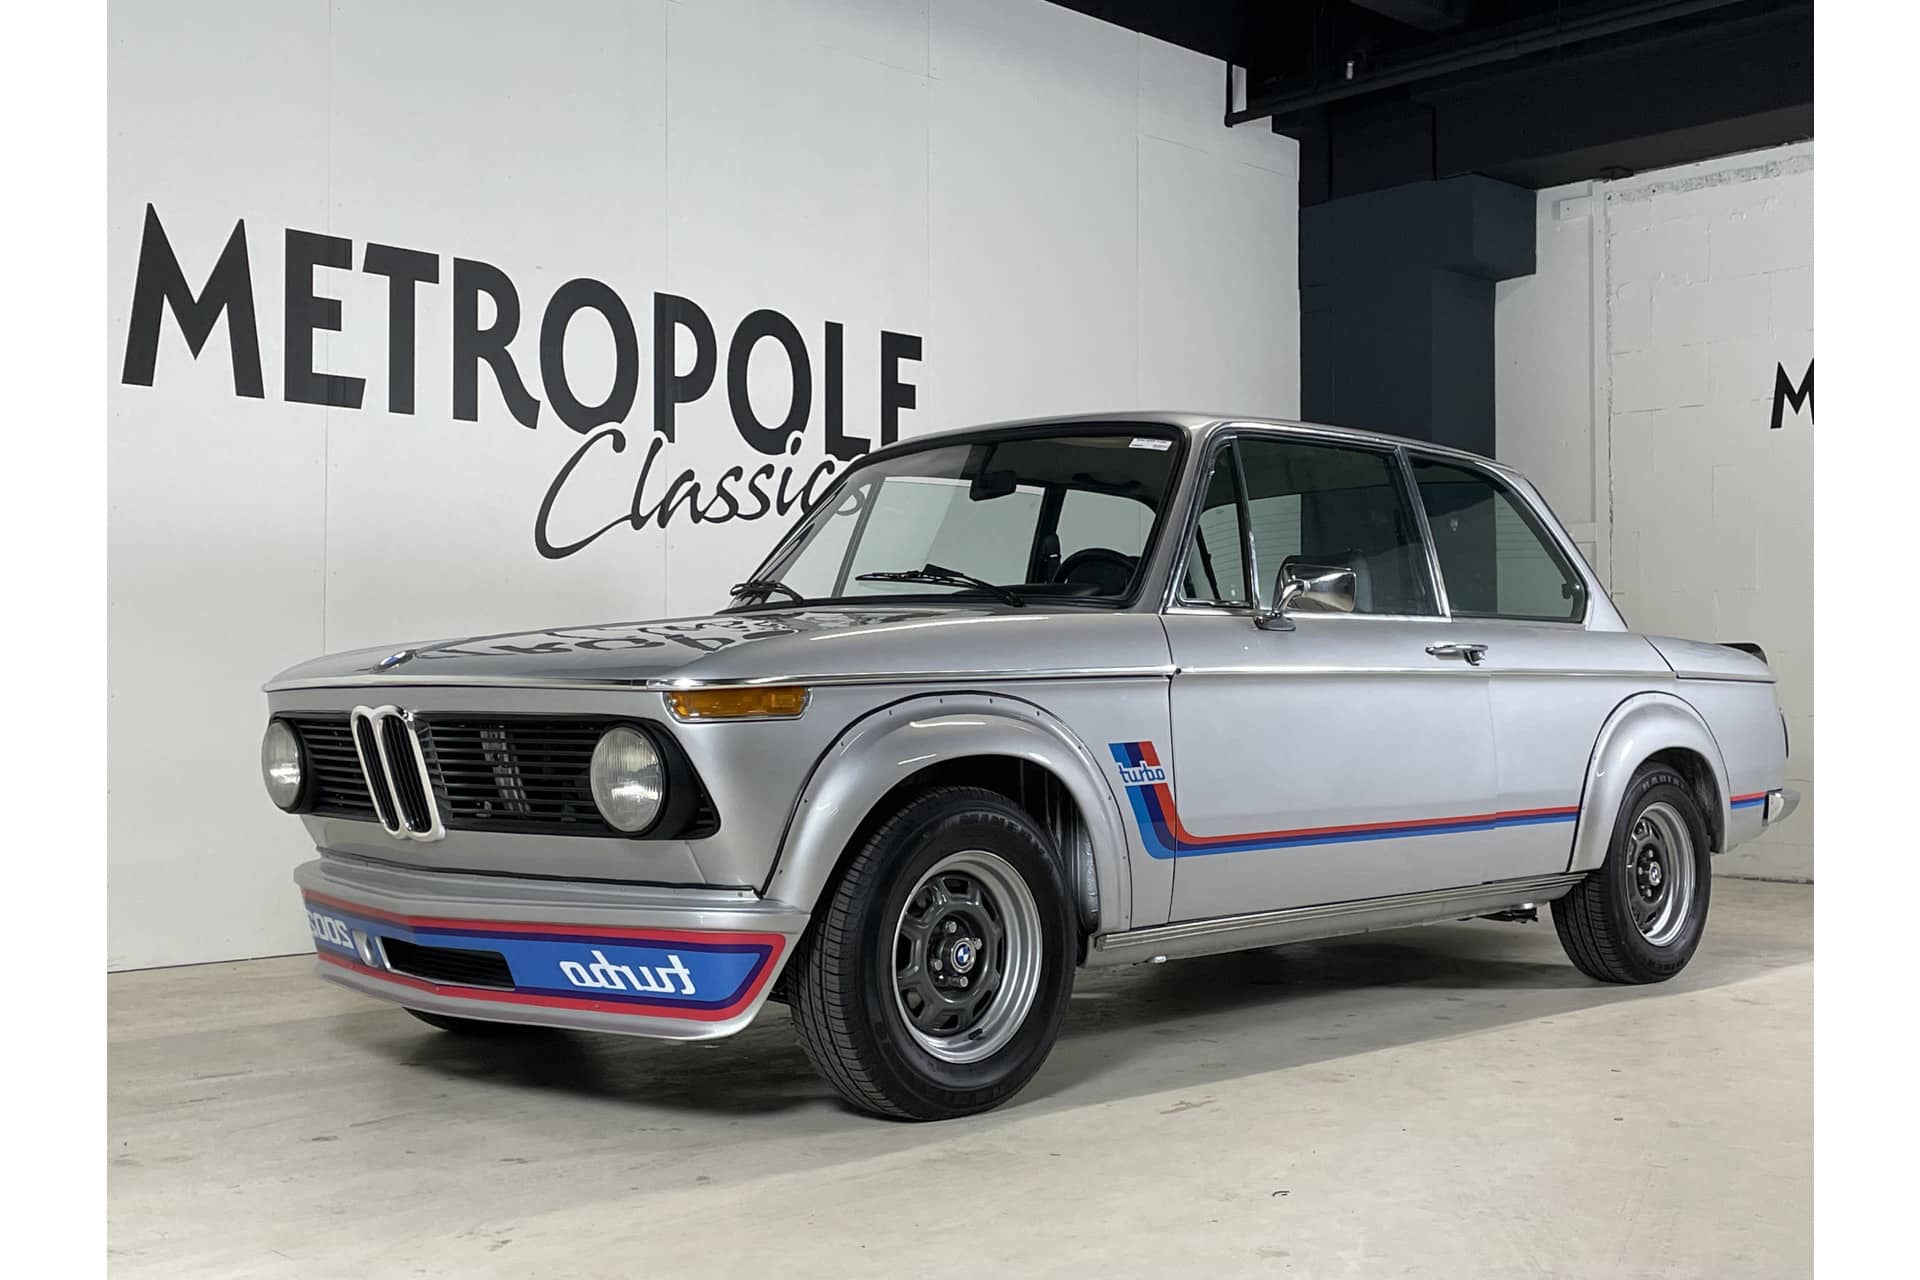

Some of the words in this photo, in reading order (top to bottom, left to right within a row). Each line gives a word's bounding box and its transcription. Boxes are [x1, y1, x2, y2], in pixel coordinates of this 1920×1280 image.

[121, 202, 923, 460] METROPOLE
[534, 428, 866, 560] Classics
[1119, 763, 1166, 783] turbo
